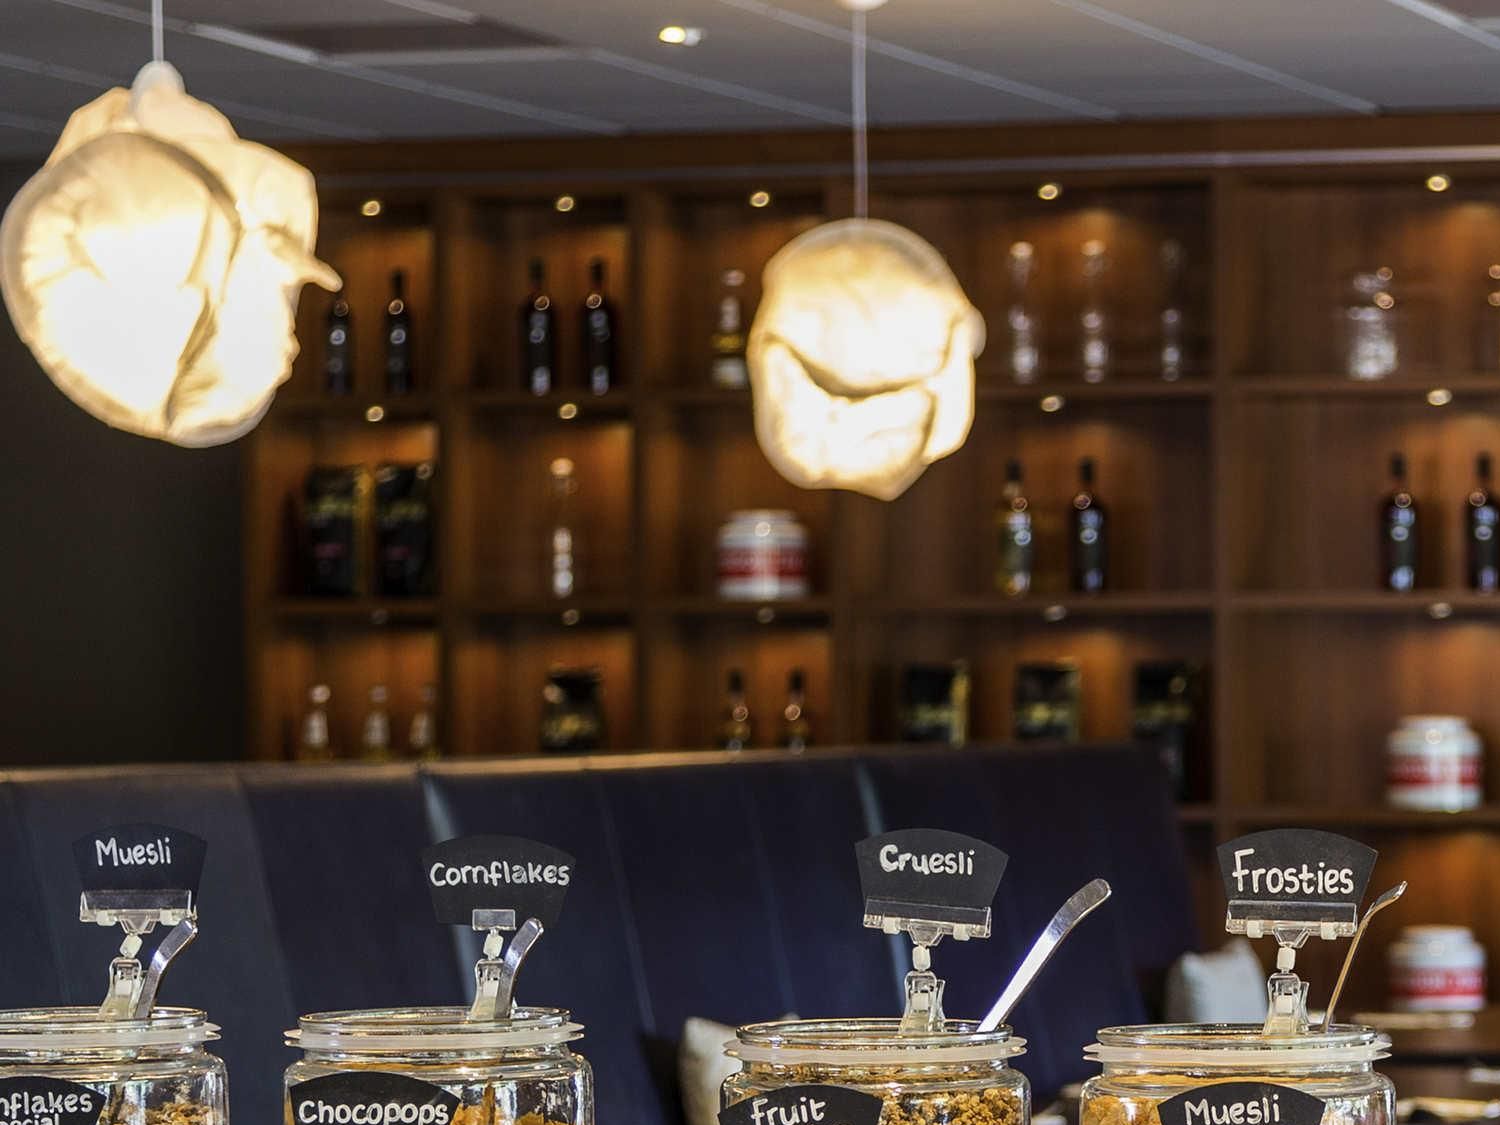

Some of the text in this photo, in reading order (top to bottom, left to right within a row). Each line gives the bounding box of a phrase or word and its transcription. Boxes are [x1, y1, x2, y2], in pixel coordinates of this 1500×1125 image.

[95, 837, 171, 867] Muesli
[880, 844, 975, 876] Cruesli
[429, 860, 571, 887] Cornflakes
[1232, 847, 1354, 894] Frosties
